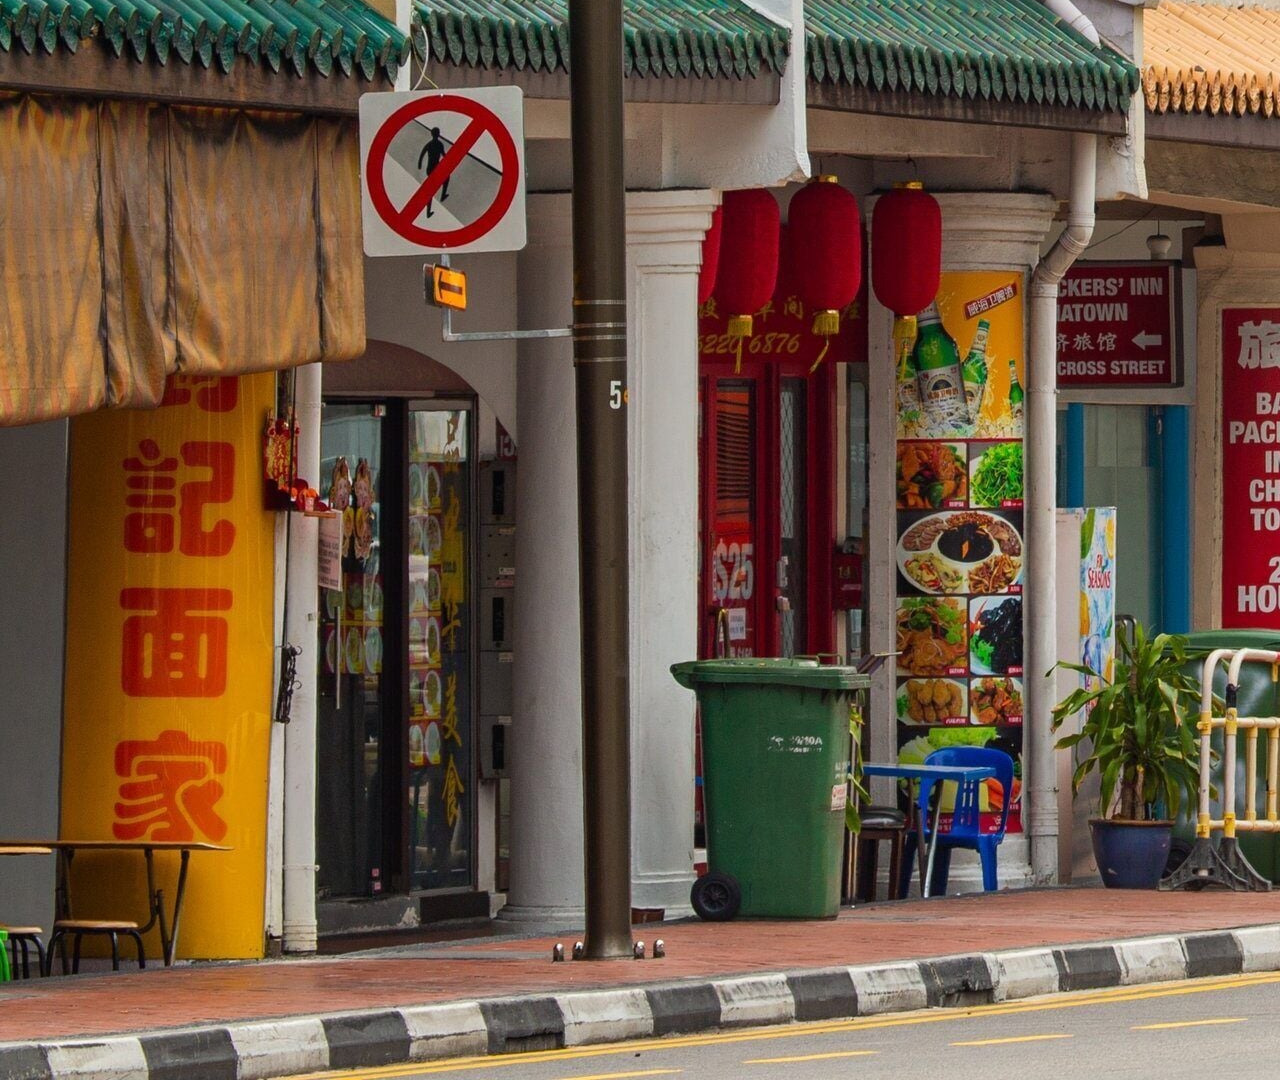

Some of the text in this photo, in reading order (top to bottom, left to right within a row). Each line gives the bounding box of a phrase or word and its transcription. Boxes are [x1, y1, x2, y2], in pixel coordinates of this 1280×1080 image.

[1057, 277, 1163, 297] CKERS' INN
[750, 332, 800, 354] 6876
[1057, 360, 1165, 376] CROSS STREET
[609, 381, 621, 409] 5
[715, 538, 754, 606] $25
[1088, 568, 1111, 589] SEASONS
